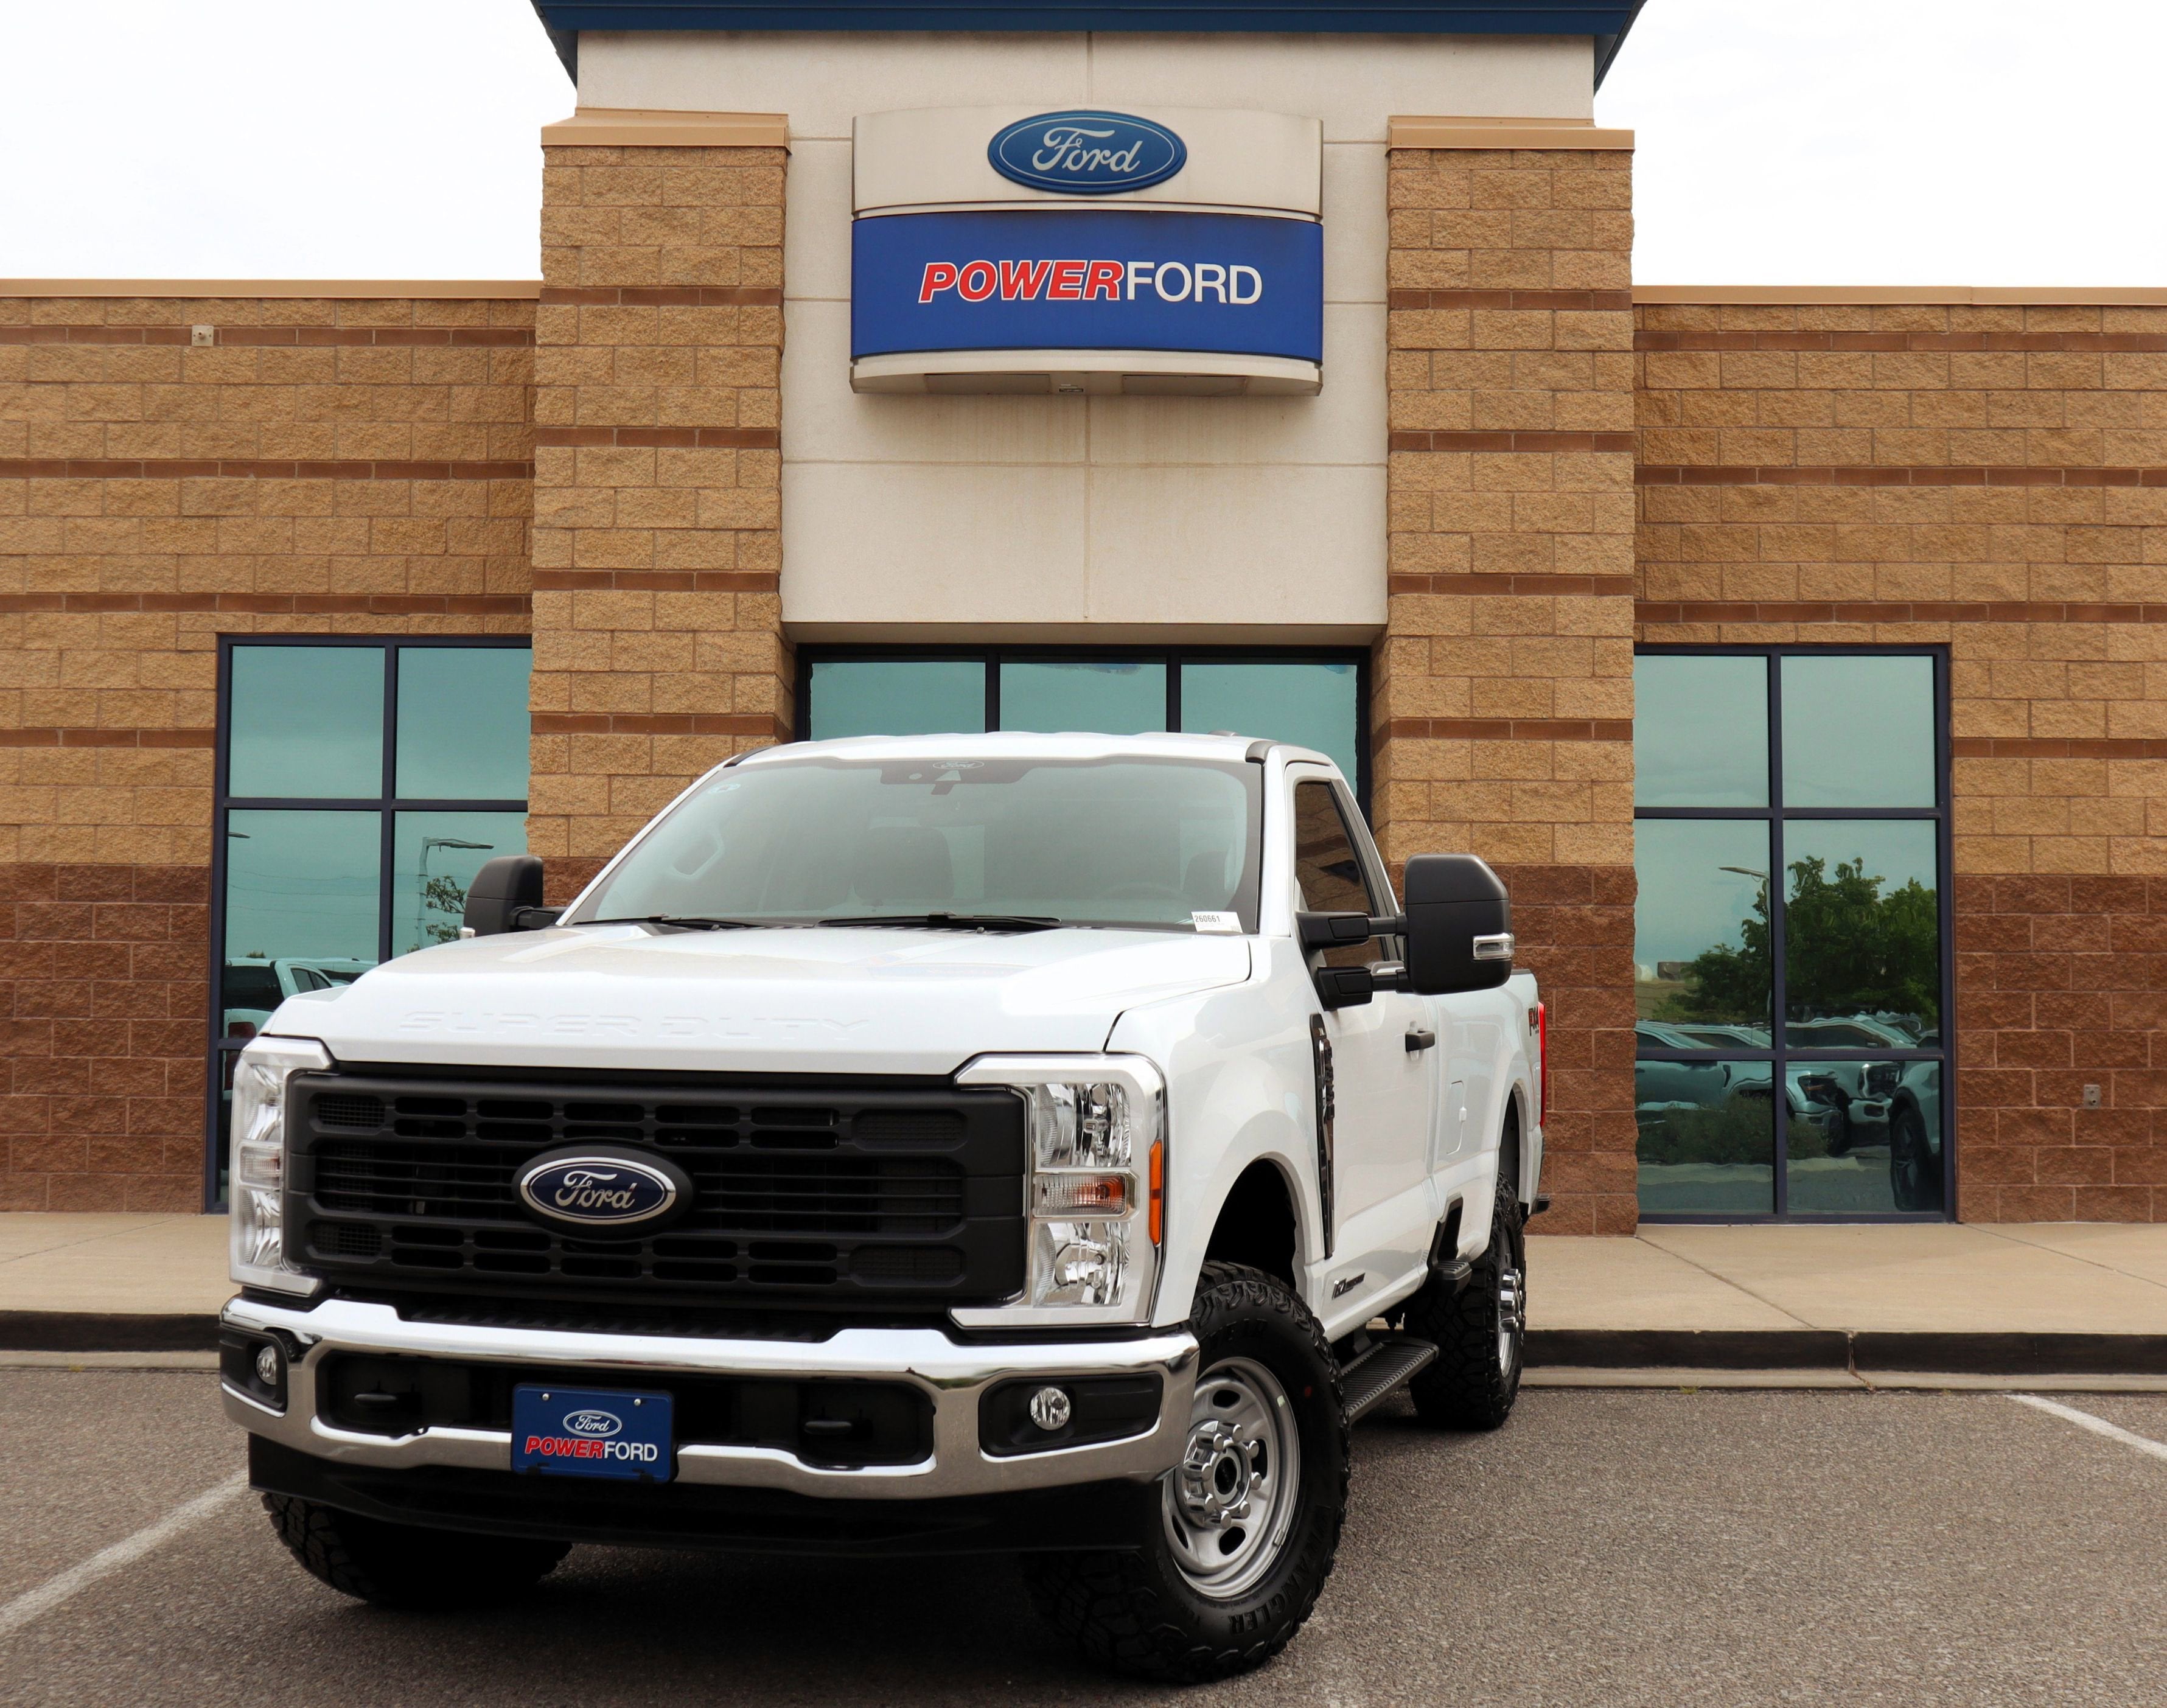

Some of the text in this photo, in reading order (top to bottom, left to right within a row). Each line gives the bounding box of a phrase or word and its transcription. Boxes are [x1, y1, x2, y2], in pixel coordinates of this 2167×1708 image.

[1031, 126, 1143, 172] Ford
[1194, 915, 1221, 923] 260661
[397, 1010, 870, 1040] SUPER DUTY
[554, 1170, 638, 1208] Ford
[574, 1415, 610, 1432] Ford
